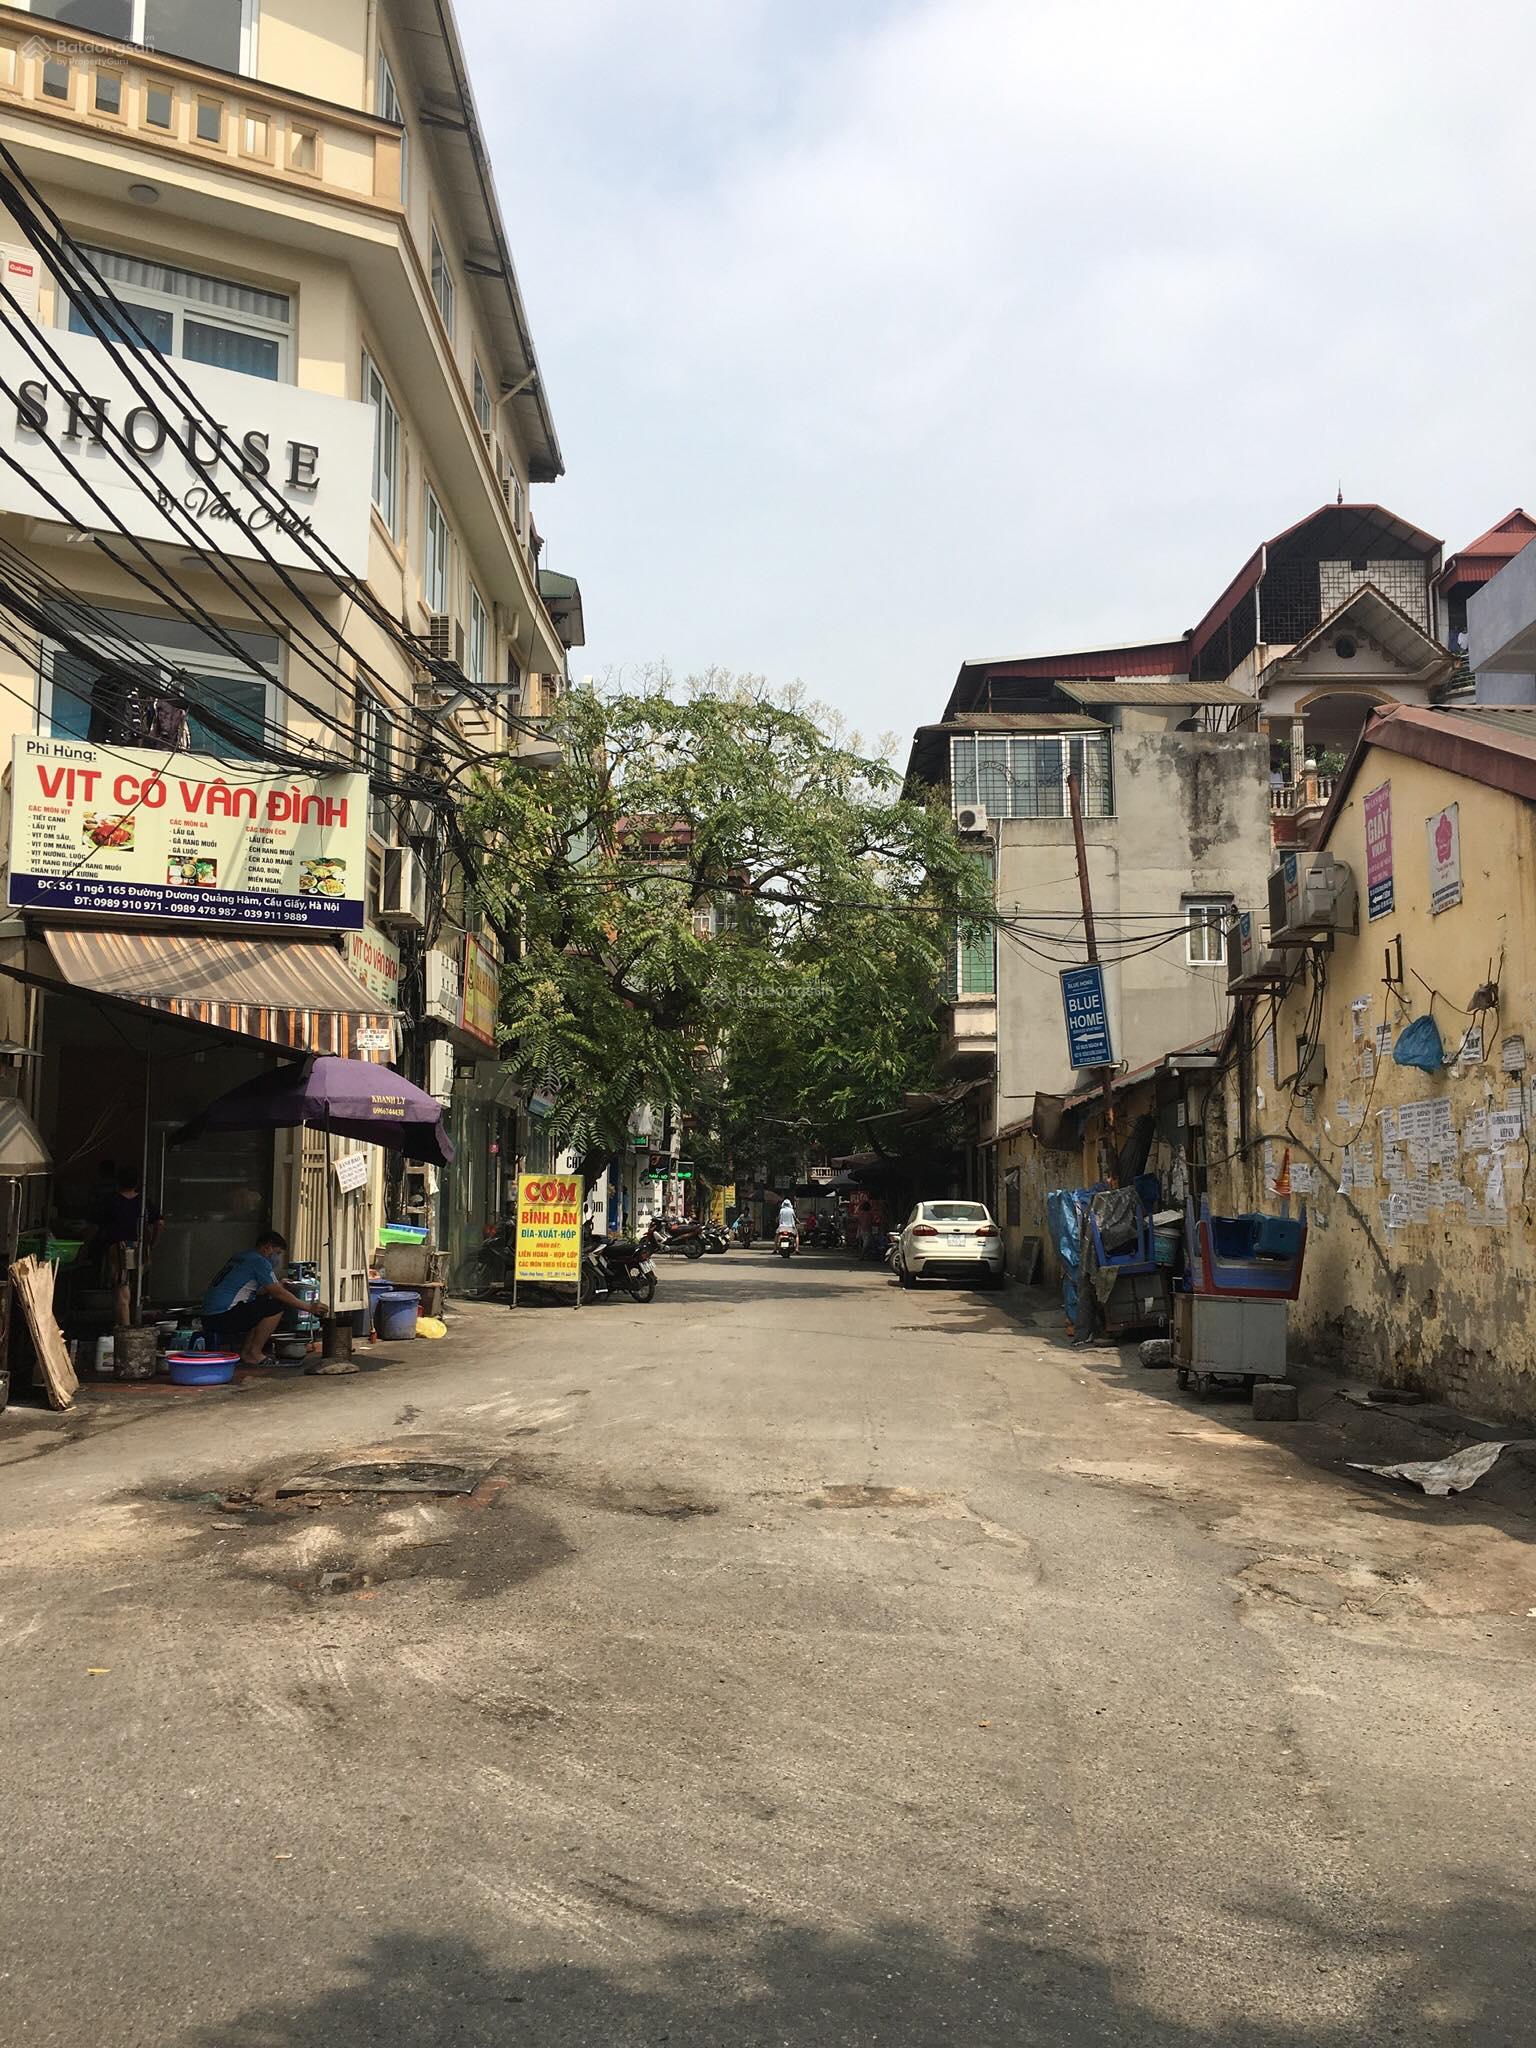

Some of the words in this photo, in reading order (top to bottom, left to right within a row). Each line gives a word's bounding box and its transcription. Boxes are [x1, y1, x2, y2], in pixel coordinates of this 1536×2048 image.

[26, 740, 49, 754] Phi
[54, 744, 97, 763] Hùng:
[36, 764, 102, 807] VỊT
[113, 767, 167, 809] CỎ
[182, 838, 200, 847] RANG
[59, 881, 72, 890] Số
[76, 883, 81, 892] 1
[84, 885, 105, 894] ngõ
[107, 886, 126, 895] 165
[128, 888, 163, 900] Đường
[165, 890, 199, 903] Dương
[202, 892, 235, 905] Quảng
[236, 895, 262, 906] Hàm,
[264, 896, 282, 907] Cầu
[283, 898, 307, 910] Giấy,
[309, 901, 322, 911] Hà
[324, 902, 340, 913] Nội
[74, 896, 92, 905] ĐT:
[94, 898, 120, 908] 0989
[123, 900, 142, 909] 910
[144, 902, 162, 911] 971
[170, 903, 196, 913] 0989
[198, 906, 216, 915] 478
[218, 907, 236, 916] 987
[244, 909, 262, 918] 039
[264, 911, 281, 920] 911
[284, 912, 308, 922] 9889
[1068, 994, 1100, 1012] BLUE
[1070, 1012, 1104, 1030] HOME
[524, 1178, 577, 1202] CƠM
[522, 1208, 549, 1225] BÌNH
[553, 1210, 577, 1225] DÂN
